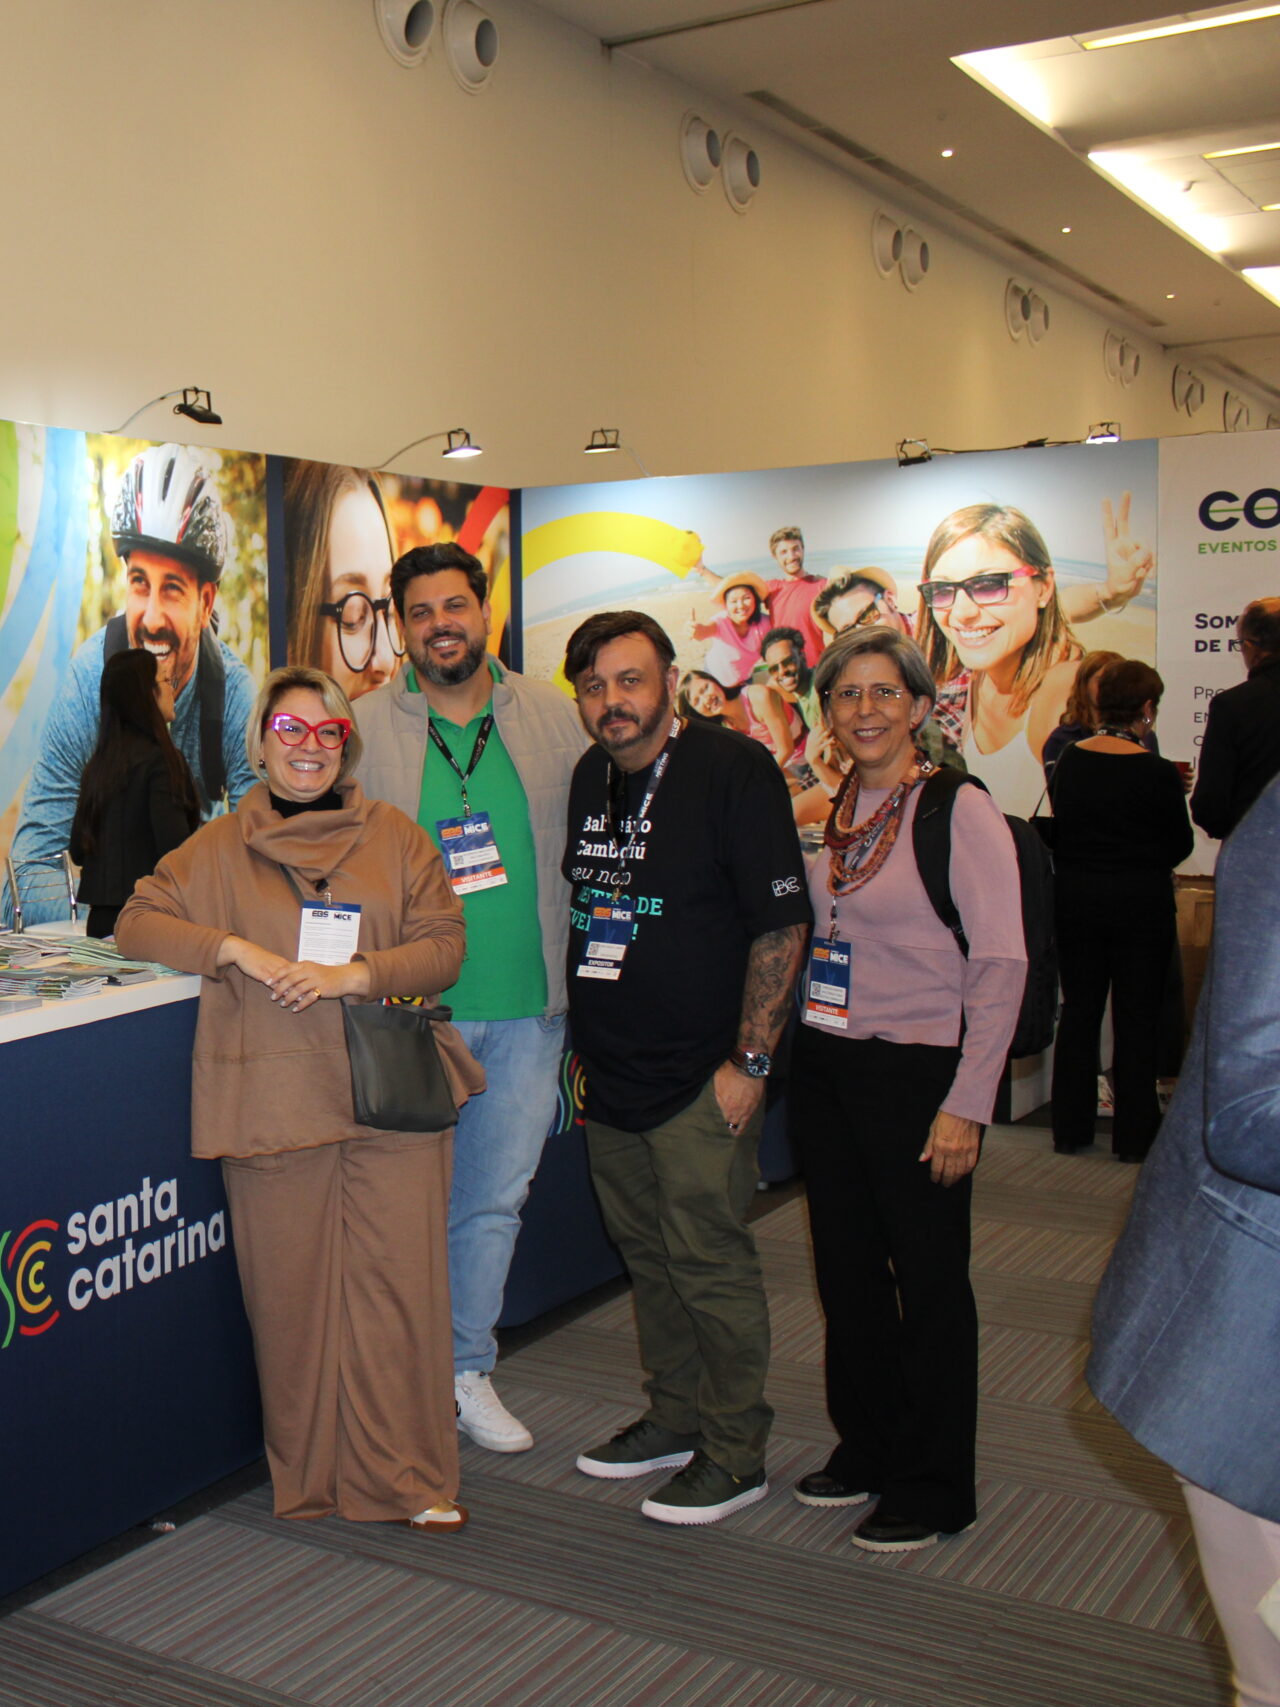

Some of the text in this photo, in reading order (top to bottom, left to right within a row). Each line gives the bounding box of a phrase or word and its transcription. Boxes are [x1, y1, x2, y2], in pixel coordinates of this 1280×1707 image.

[1198, 539, 1277, 554] EVENTOS
[1195, 640, 1221, 652] DE
[639, 793, 654, 818] MICE
[636, 897, 663, 916] DE
[333, 913, 352, 921] MICE
[67, 1176, 177, 1255] santa
[68, 1210, 225, 1311] catarina
